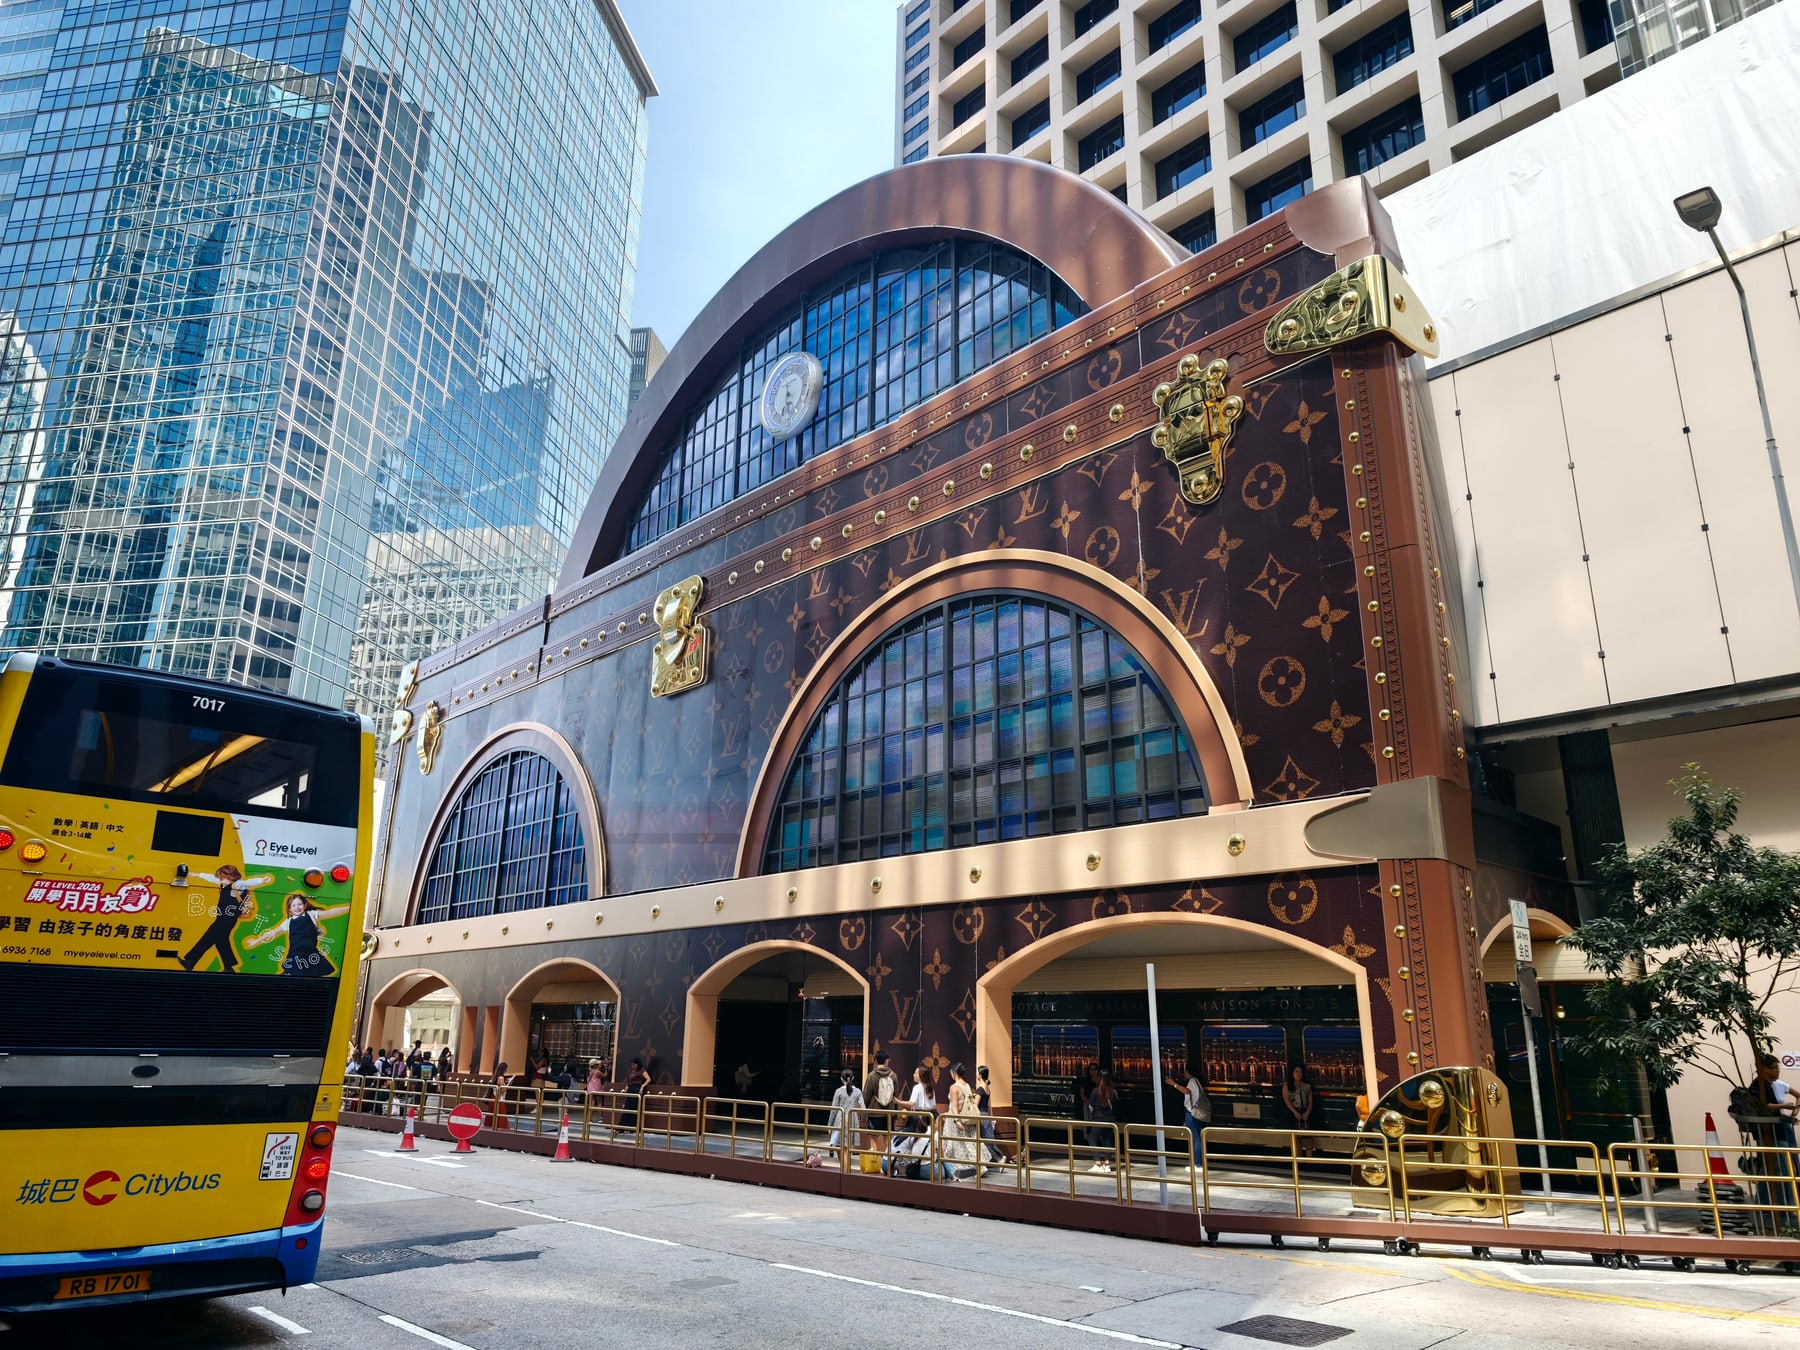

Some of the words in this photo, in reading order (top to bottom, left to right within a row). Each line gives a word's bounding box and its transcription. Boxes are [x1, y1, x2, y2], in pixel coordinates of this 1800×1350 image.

[192, 695, 226, 712] 7017
[106, 824, 125, 833] 中文
[269, 842, 289, 853] Eye
[290, 844, 318, 856] Level
[34, 880, 51, 888] EYE
[52, 881, 77, 890] LEVEL
[77, 882, 102, 891] 2026
[38, 918, 183, 942] 由孩子的角度出發
[2, 945, 27, 955] 6936
[30, 947, 51, 956] 7168
[63, 949, 141, 960] myeyelevel.com
[1197, 1000, 1260, 1012] MAISON
[125, 1171, 222, 1197] Citybus
[15, 1178, 80, 1205] 城巴
[69, 1278, 97, 1296] RB
[104, 1274, 140, 1292] 1701
